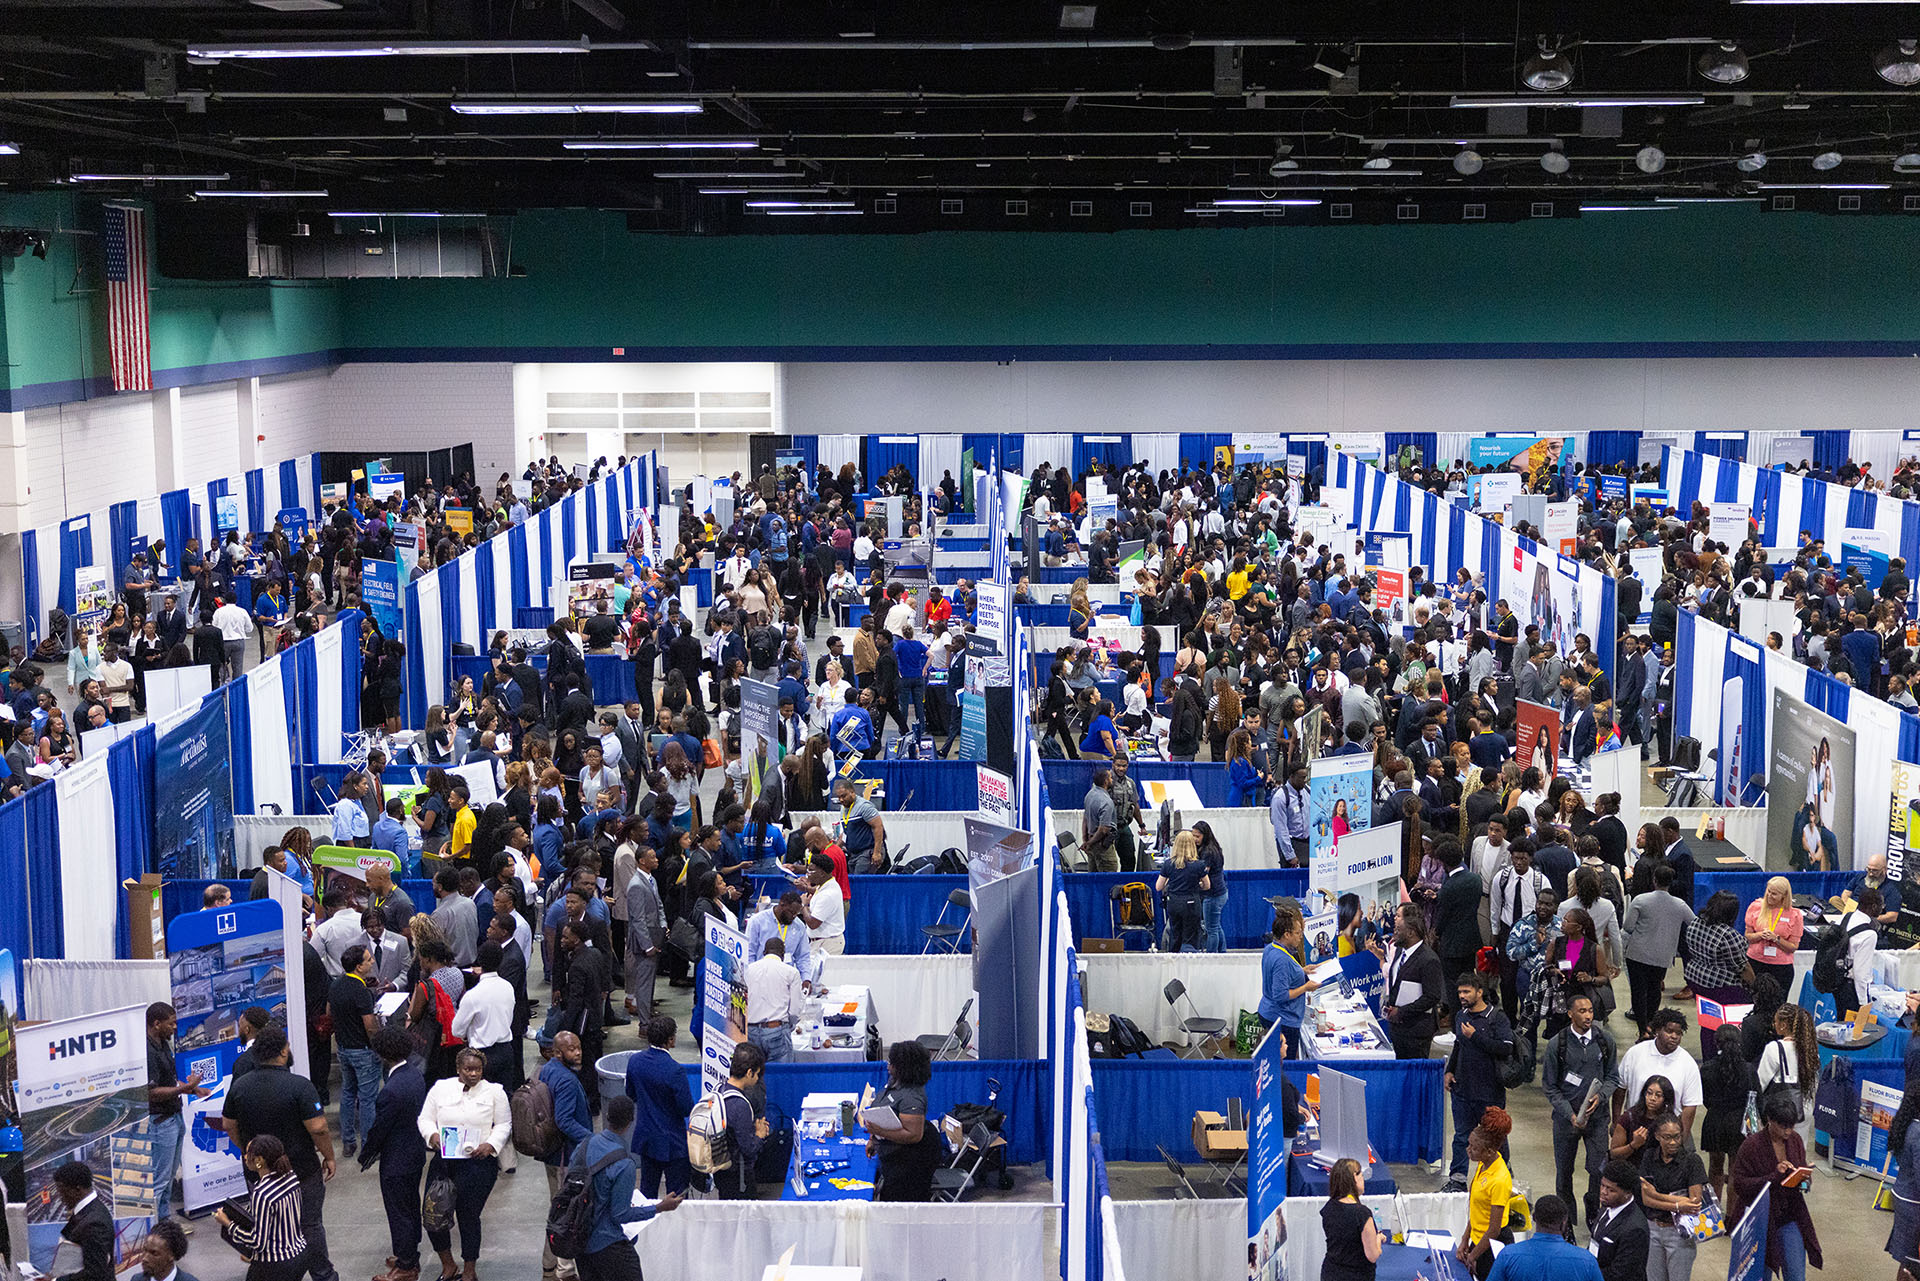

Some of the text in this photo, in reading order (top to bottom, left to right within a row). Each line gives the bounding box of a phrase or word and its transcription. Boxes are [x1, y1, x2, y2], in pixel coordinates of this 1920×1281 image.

[979, 595, 995, 603] WHERE
[979, 602, 1004, 613] POTENTIAL
[979, 618, 999, 629] PURPOSE
[744, 699, 770, 714] MAKING THE
[744, 708, 769, 723] IMPOSSIBLE
[180, 733, 208, 767] Methodist
[979, 780, 1007, 800] THE FUTURE
[986, 775, 1006, 791] MAKING
[980, 799, 989, 810] THE
[985, 792, 1011, 810] COUNTING
[981, 853, 994, 862] 2007
[1315, 845, 1338, 858] WO
[1887, 834, 1905, 881] GROW
[1348, 855, 1393, 875] FOOD LION
[1308, 918, 1334, 931] FOOD LION
[706, 960, 723, 977] WHERE
[705, 973, 731, 993] ENGINEERS
[1350, 975, 1370, 988] Work
[705, 984, 723, 1003] MASTER
[705, 995, 727, 1019] BUSINESS
[1245, 1025, 1260, 1033] LETT
[49, 1030, 117, 1060] HNTB
[704, 1063, 718, 1079] LEARN
[1869, 1087, 1884, 1096] FLUOR
[203, 1179, 214, 1188] We
